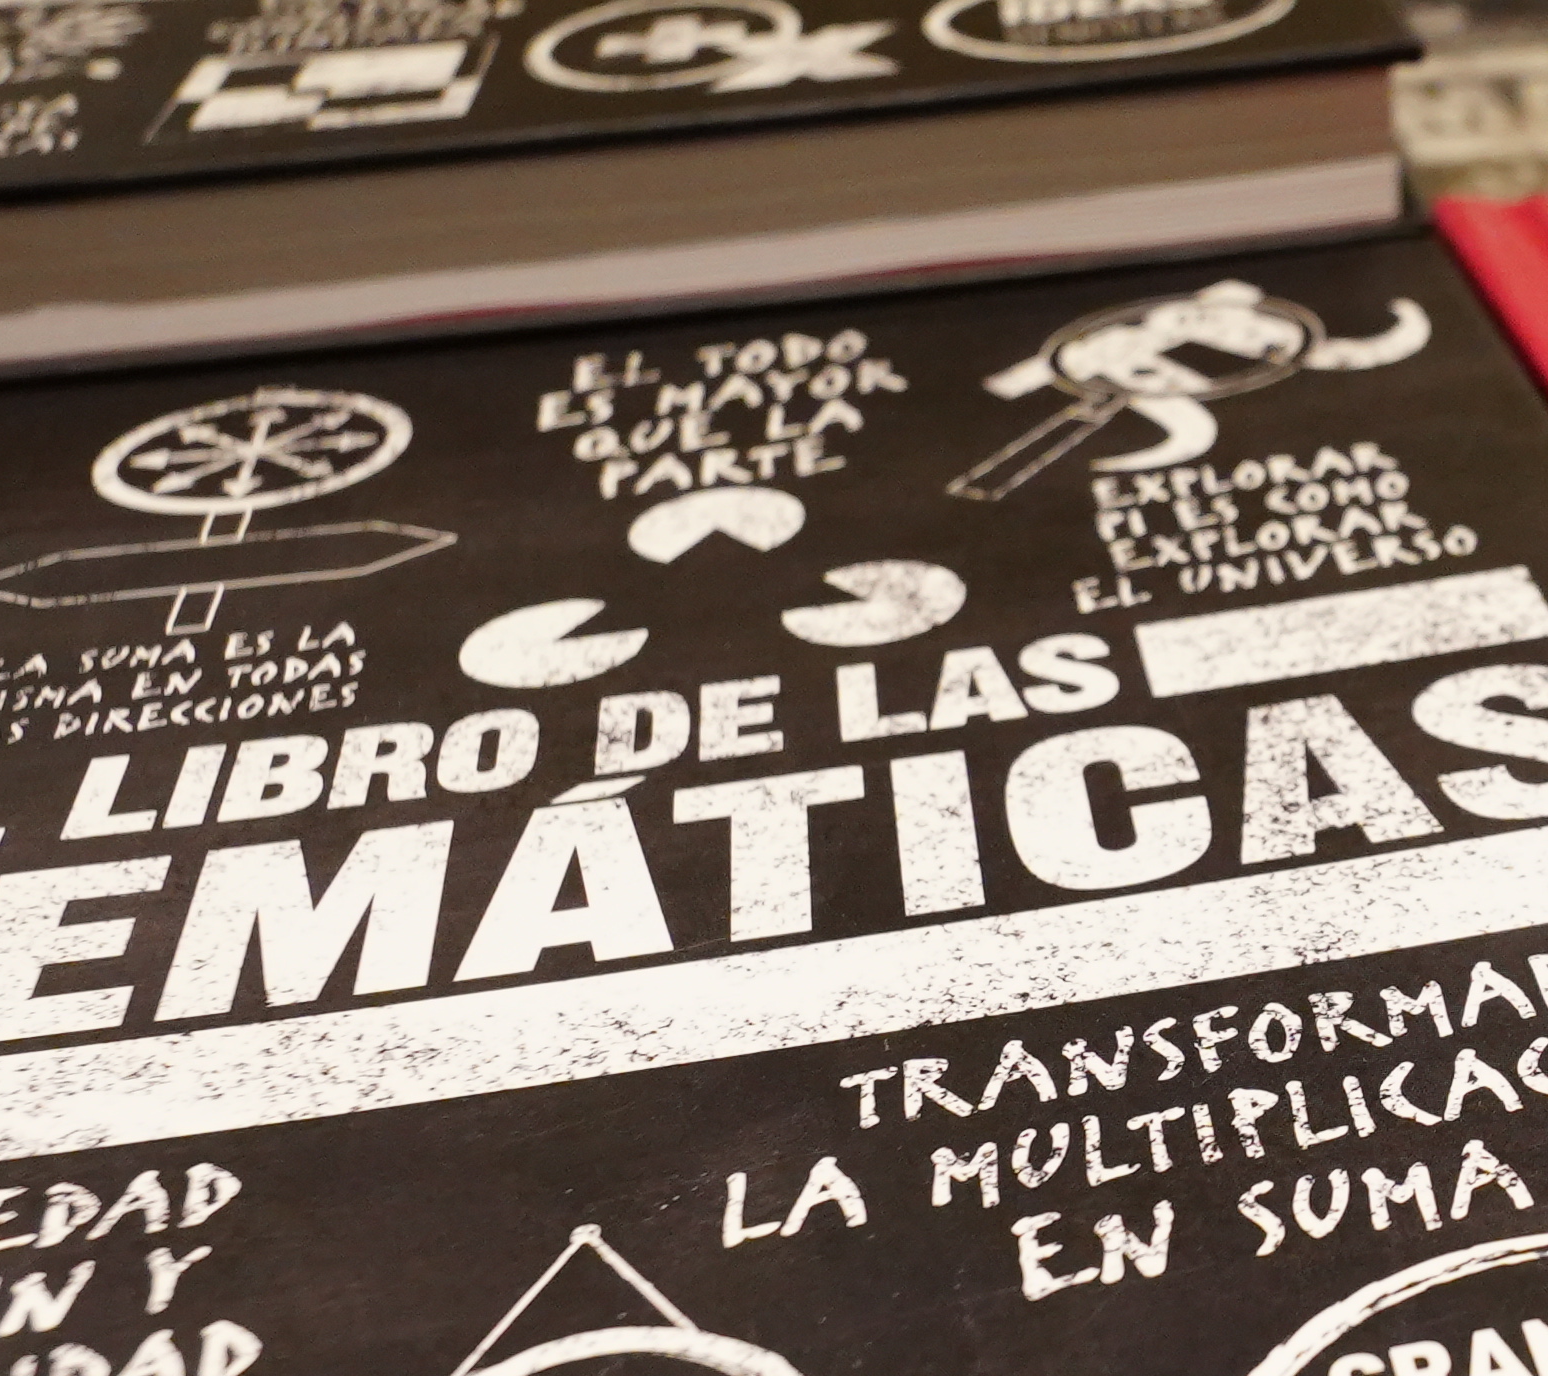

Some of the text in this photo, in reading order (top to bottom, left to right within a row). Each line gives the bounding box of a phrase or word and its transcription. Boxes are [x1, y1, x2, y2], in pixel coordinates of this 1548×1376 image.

[537, 357, 910, 434] ES MAYOR
[572, 327, 870, 393] EL TODO
[572, 395, 867, 466] QUE LA
[600, 438, 848, 502] PARTE
[1091, 441, 1403, 513] EXPLORAR
[1094, 468, 1413, 544] PI ES COMO
[1070, 522, 1480, 616] EL UNIVERSO
[1108, 501, 1432, 573] EXPLORAR
[77, 640, 198, 676] SUMA
[222, 629, 276, 663] ES
[295, 620, 358, 650] LA
[130, 666, 204, 701] EN
[227, 648, 368, 690] TODAS
[52, 681, 361, 741] DIRECCIONES
[58, 707, 542, 841] LIBRO
[591, 674, 786, 777] DE
[834, 632, 1121, 745] LAS
[720, 1156, 868, 1251] LA
[1015, 1138, 1538, 1304] EN SUMA
[144, 1244, 214, 1316] Y
